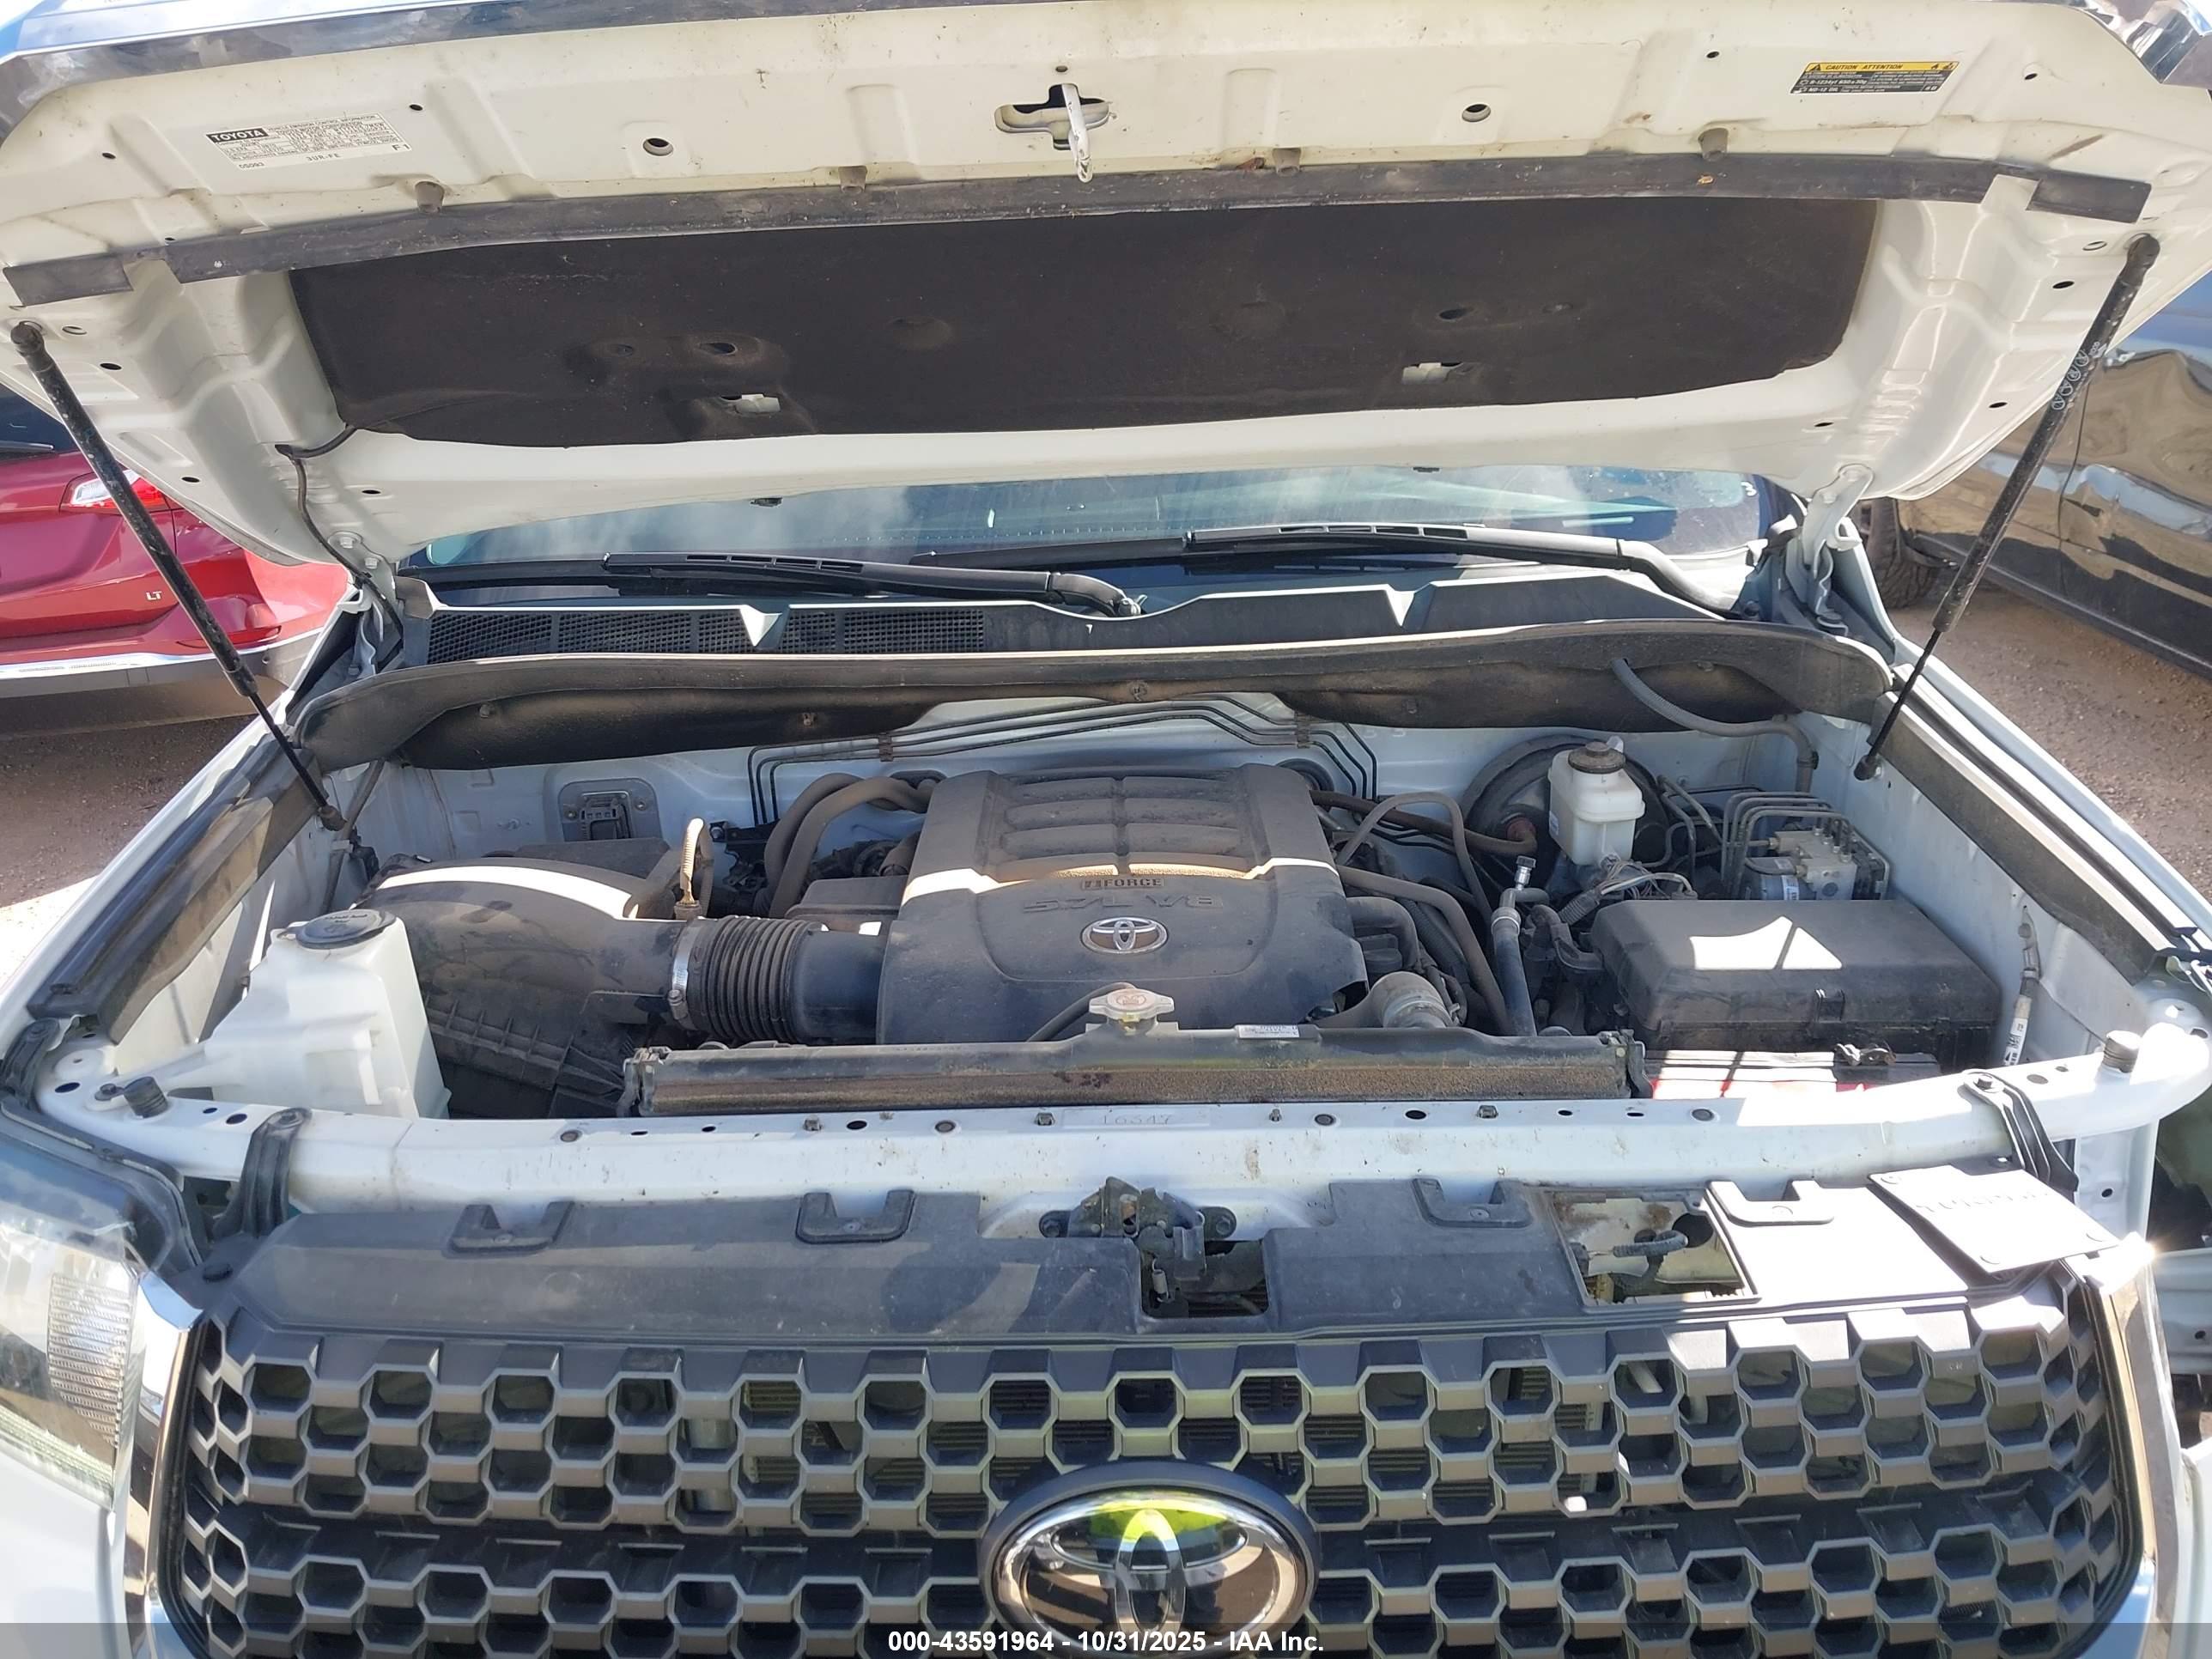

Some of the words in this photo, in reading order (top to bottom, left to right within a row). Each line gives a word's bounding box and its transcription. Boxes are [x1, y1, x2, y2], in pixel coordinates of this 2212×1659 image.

[211, 130, 264, 142] TOYOTA
[145, 590, 163, 601] LT
[1146, 894, 1224, 909] V8
